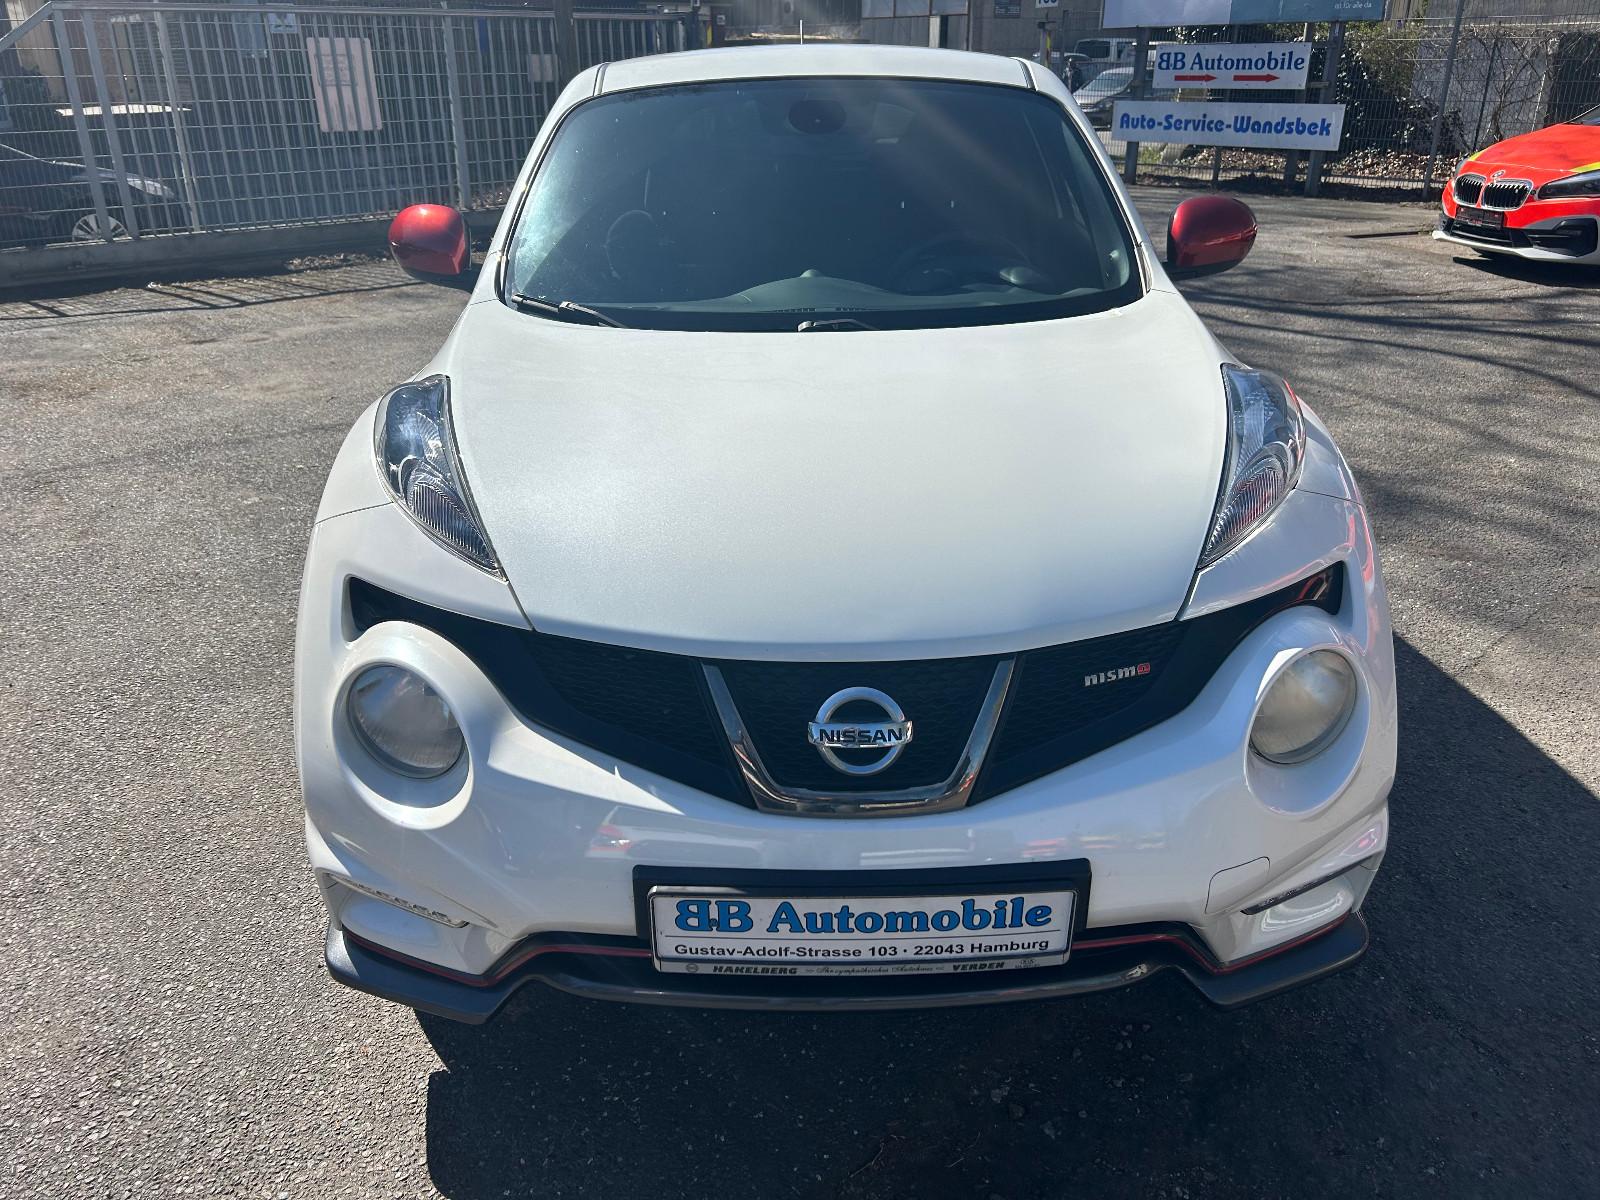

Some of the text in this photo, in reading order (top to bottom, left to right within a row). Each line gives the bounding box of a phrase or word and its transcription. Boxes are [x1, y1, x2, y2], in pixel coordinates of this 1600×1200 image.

[1190, 50, 1305, 71] Automobile
[1119, 112, 1331, 136] Auto-Service-Wandsbek
[819, 727, 903, 743] NISSAN
[766, 896, 1053, 934] Automobile
[674, 939, 1050, 958] Gustav-Adolf-Strasse 103 22043 Hamburg
[952, 962, 1005, 971] VERDEN
